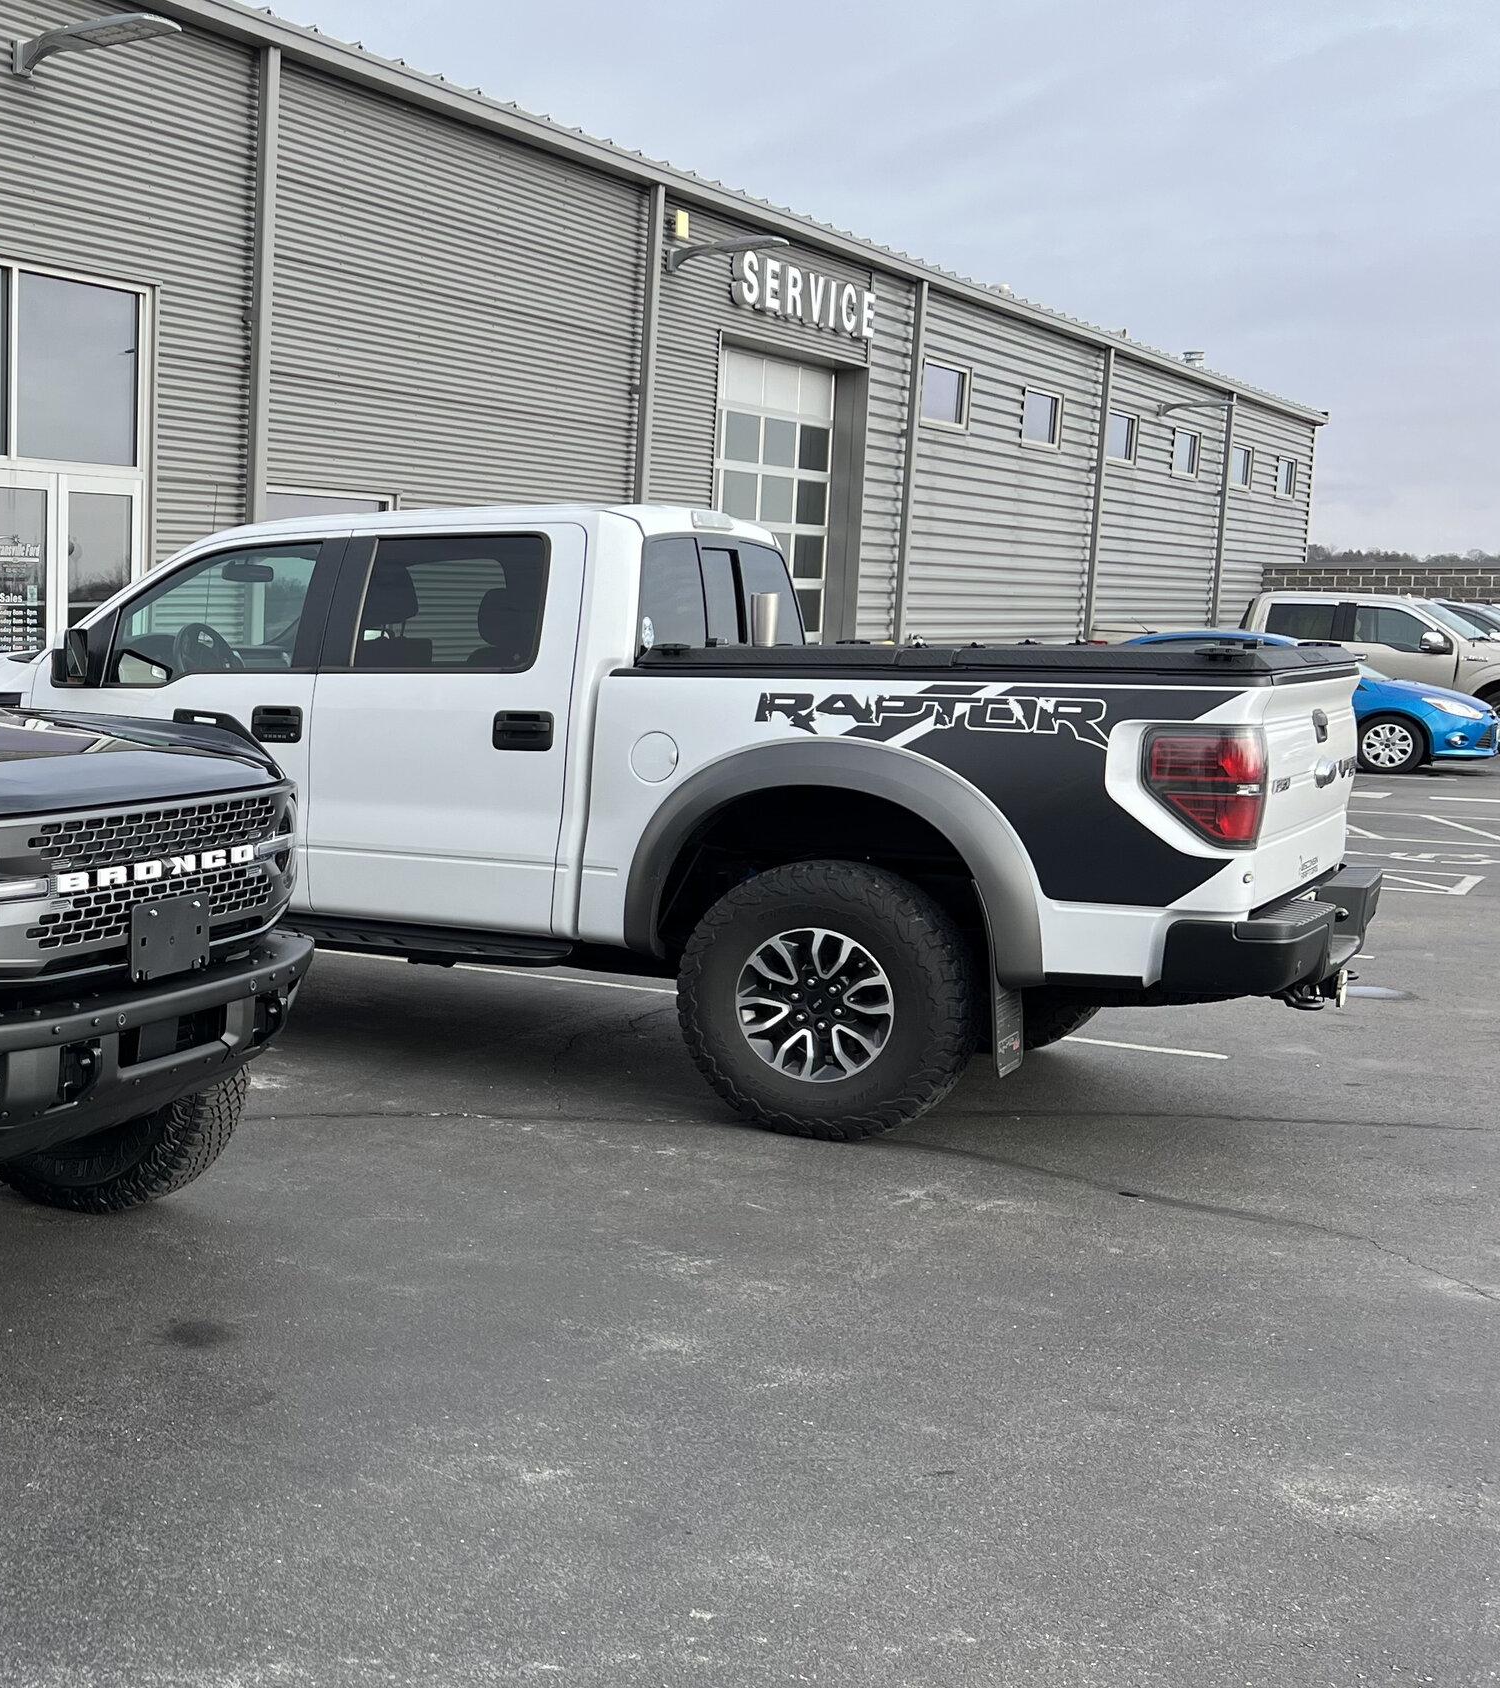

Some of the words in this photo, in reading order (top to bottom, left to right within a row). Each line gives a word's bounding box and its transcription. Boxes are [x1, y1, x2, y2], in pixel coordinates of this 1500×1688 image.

[731, 250, 876, 340] SERVICE
[0, 592, 23, 603] Sales
[754, 690, 1109, 750] RAPTOR
[56, 843, 255, 895] BRONCO
